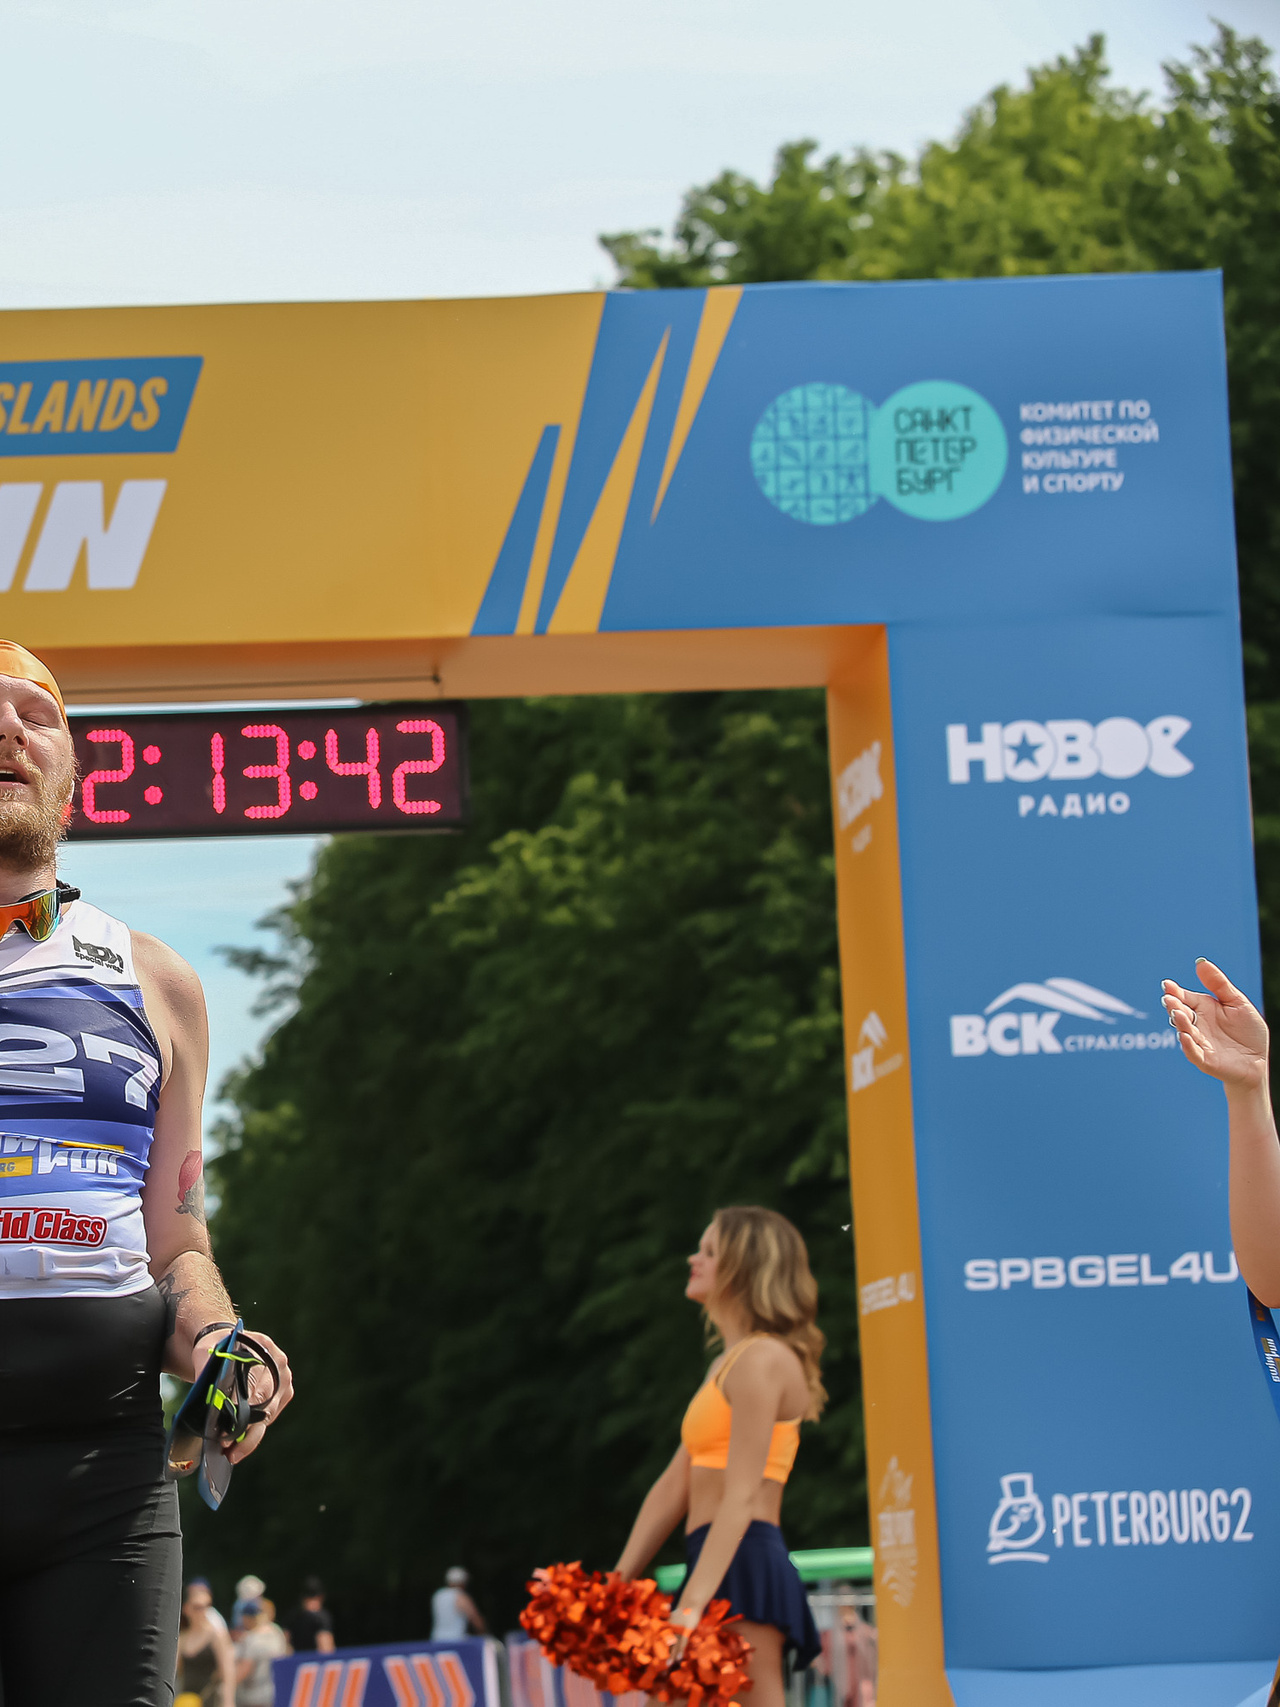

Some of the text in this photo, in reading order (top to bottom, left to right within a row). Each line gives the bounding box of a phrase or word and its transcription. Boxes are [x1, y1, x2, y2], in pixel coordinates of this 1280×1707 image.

[894, 405, 973, 434] САНКТ
[1020, 399, 1150, 422] КОМИТЕТ ПО
[1020, 419, 1159, 446] ФИЗИЧЕСКОЙ
[895, 436, 978, 465] ПЕТЕР
[1021, 448, 1118, 470] КУЛЬТУРЕ
[896, 466, 962, 496] БУРГ
[1022, 471, 1125, 494] И СПОРТУ
[61, 719, 446, 823] 2:13:42
[1018, 791, 1131, 818] РАДИО
[75, 951, 104, 967] special
[950, 1011, 1177, 1057] ВСК СТРАХОВОЙ
[33, 1212, 104, 1243] Class
[964, 1250, 1239, 1291] SPBGEL4U
[1051, 1487, 1255, 1548] PETERBURG2
